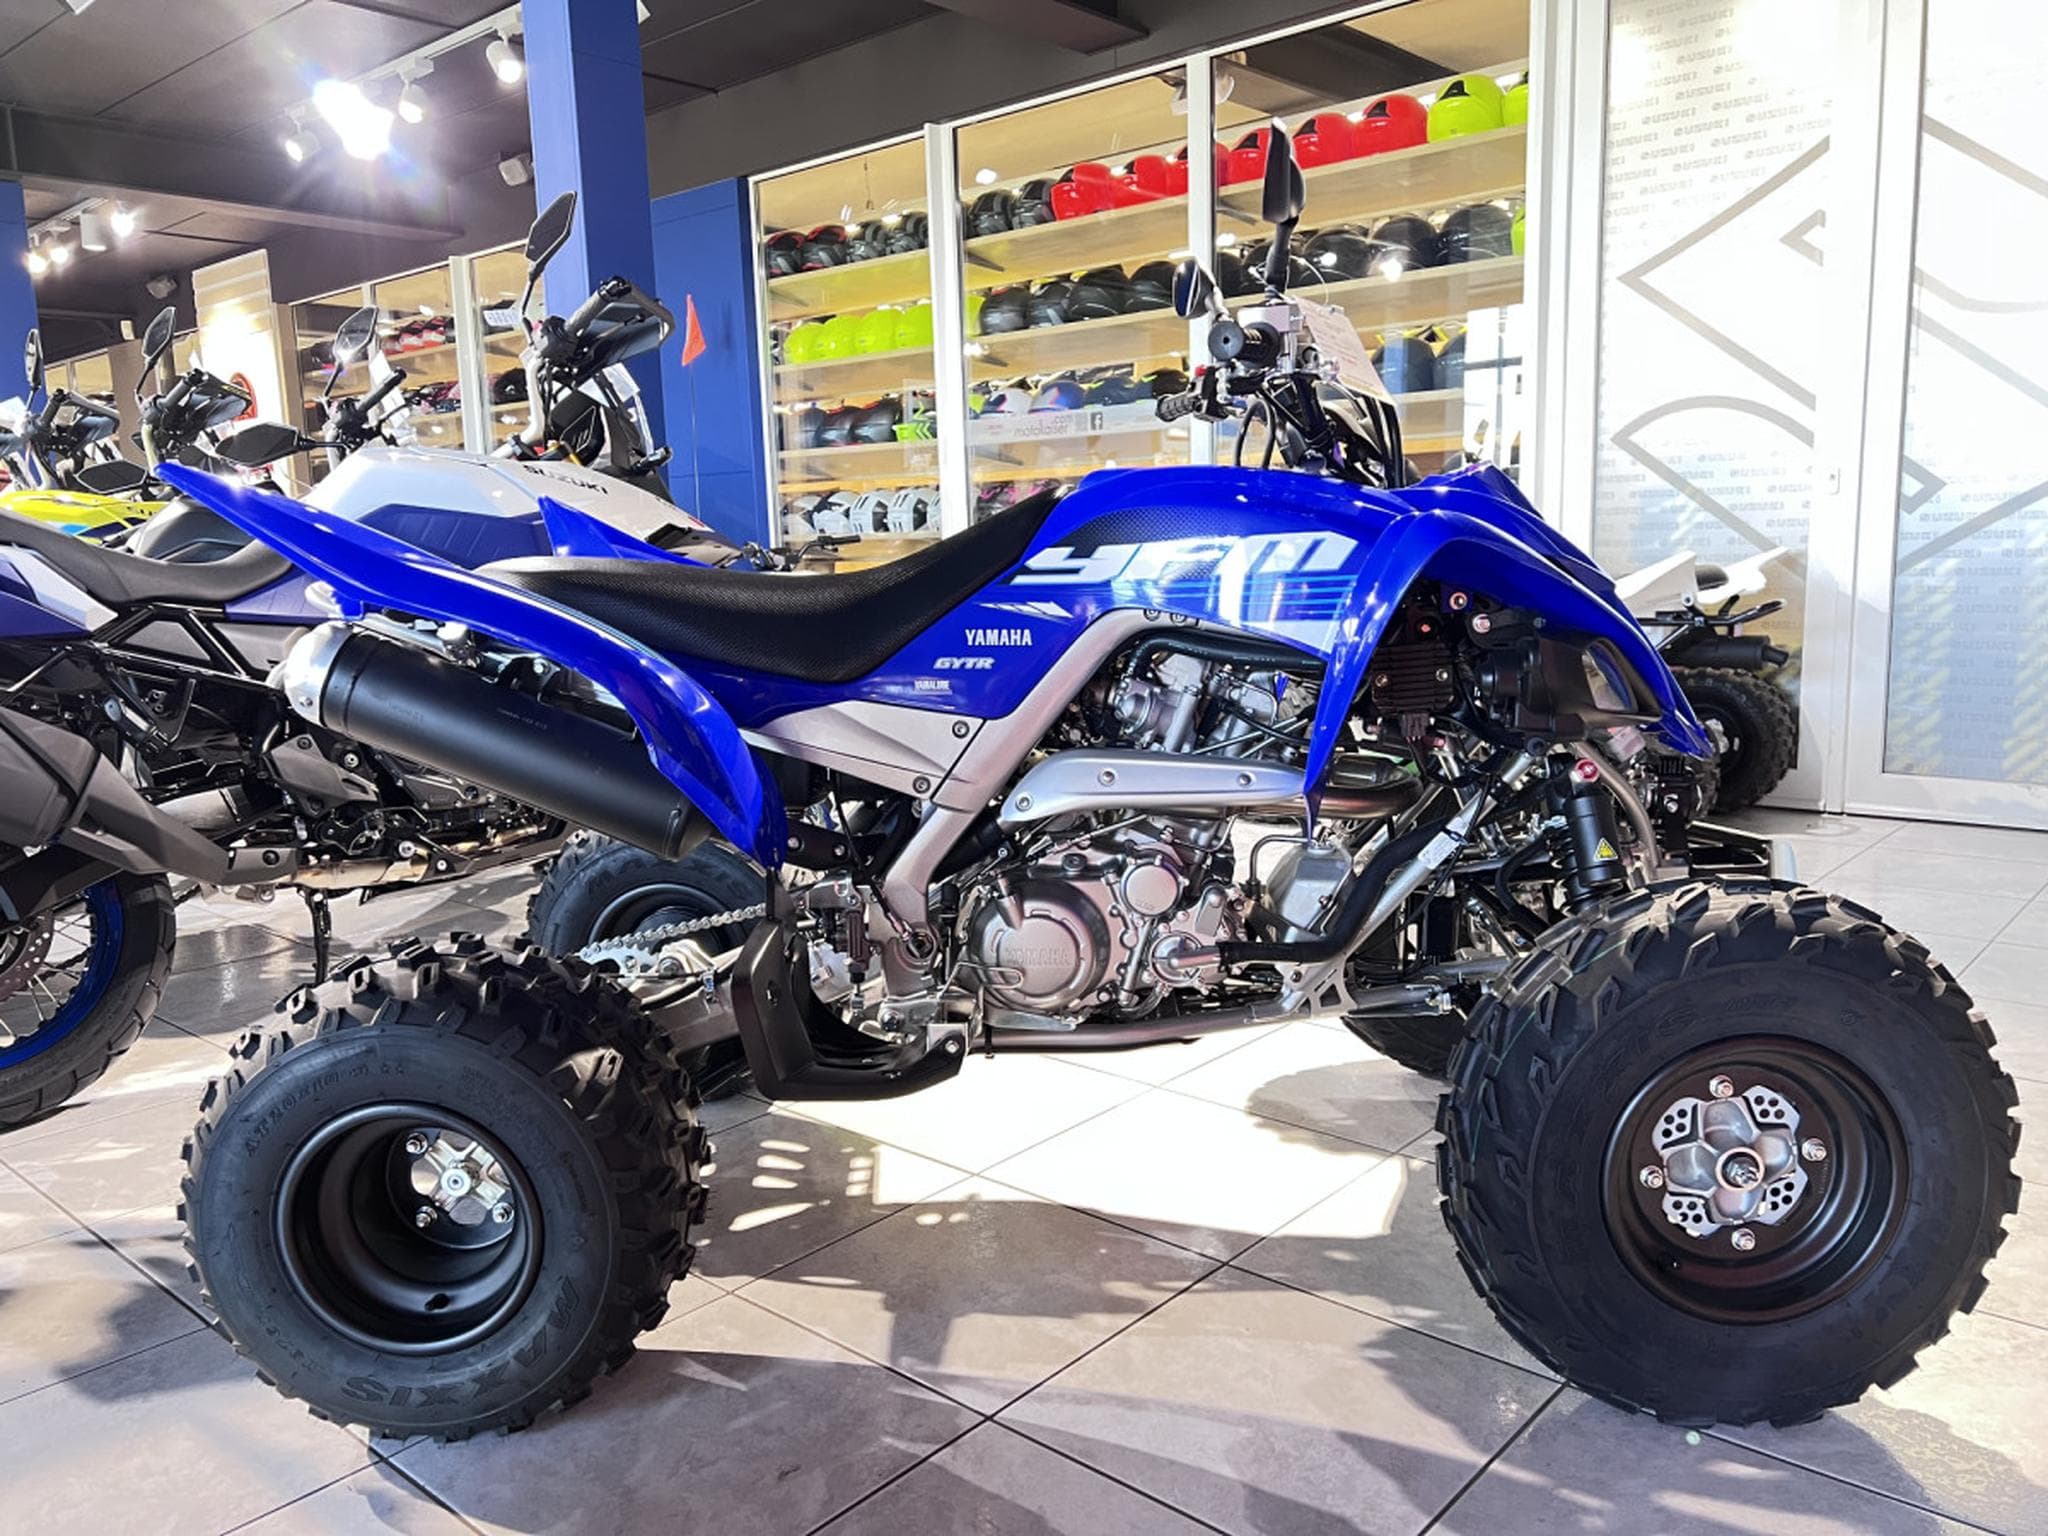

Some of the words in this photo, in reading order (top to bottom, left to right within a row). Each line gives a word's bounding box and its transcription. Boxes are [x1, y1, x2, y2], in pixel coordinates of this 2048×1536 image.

[522, 464, 609, 495] SUZUKI
[965, 628, 1032, 646] YAMAHA
[933, 656, 995, 670] GYTR
[1004, 947, 1072, 966] YAMAHA
[340, 1275, 581, 1409] MAXXIS
